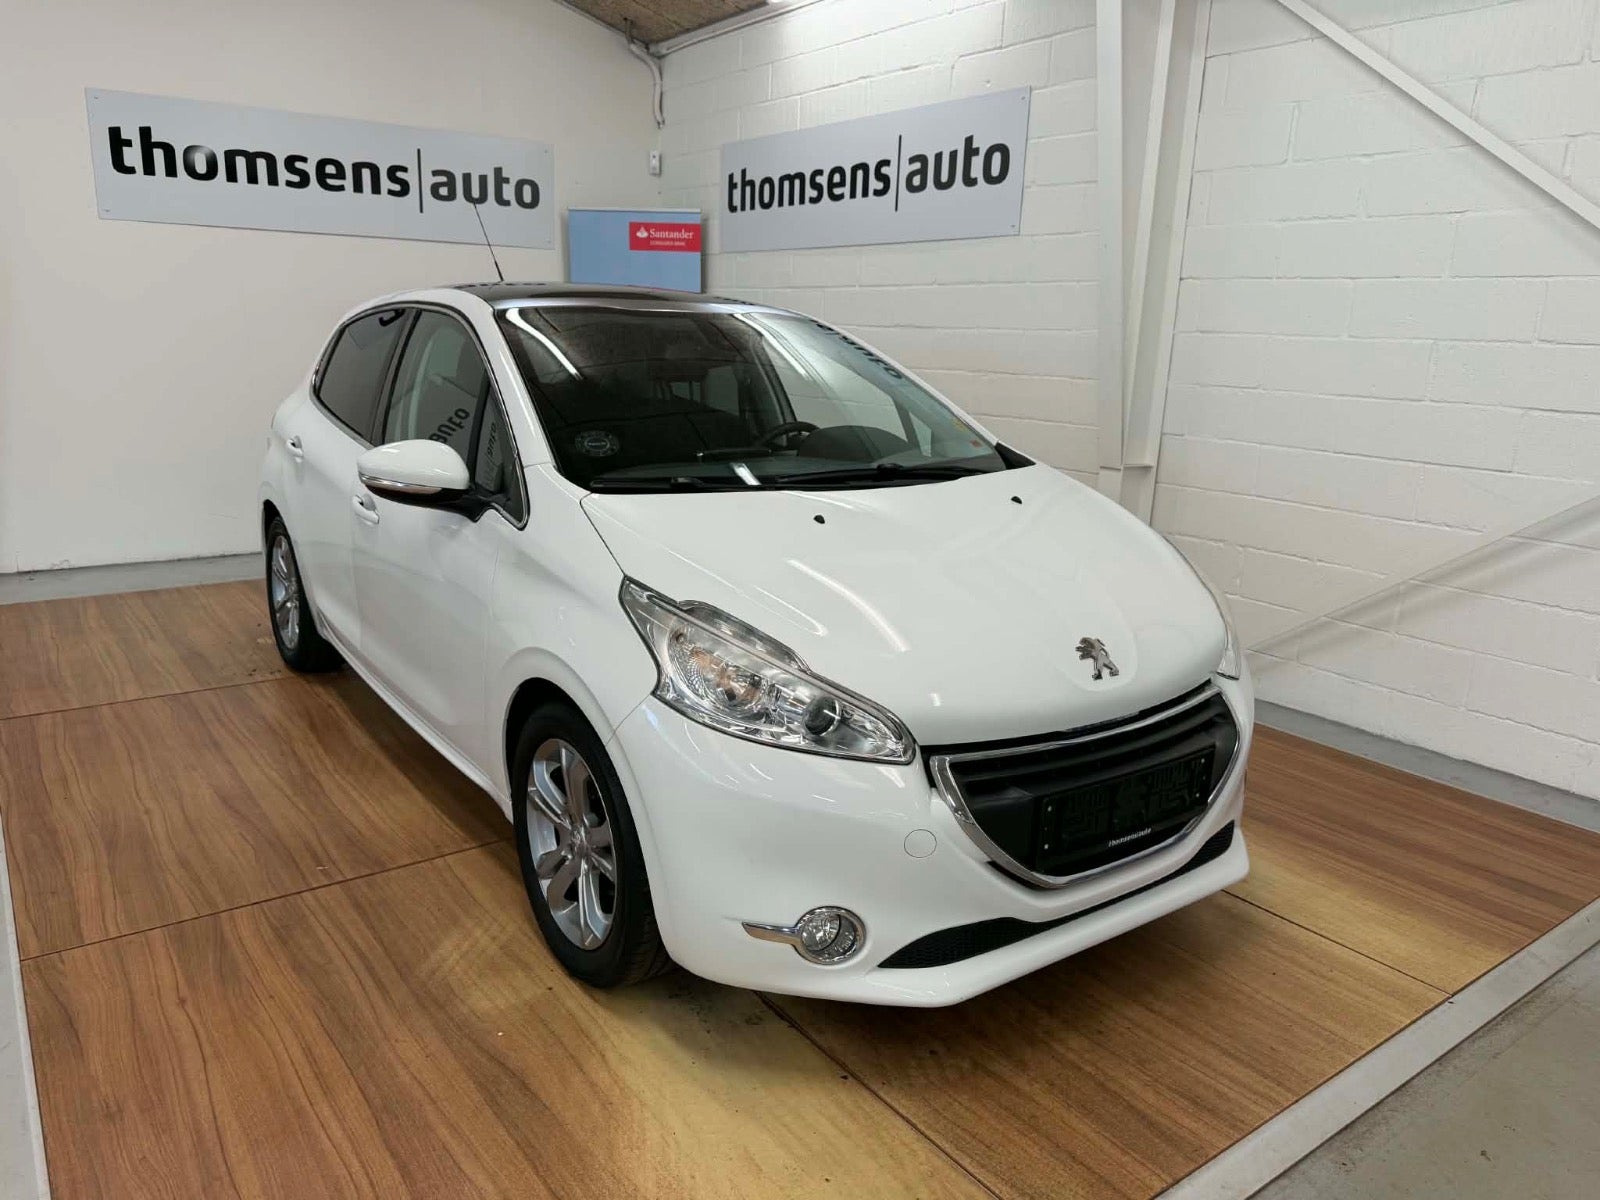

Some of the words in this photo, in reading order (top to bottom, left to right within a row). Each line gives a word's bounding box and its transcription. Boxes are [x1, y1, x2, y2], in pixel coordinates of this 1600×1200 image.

[108, 126, 410, 197] thomsens
[430, 167, 540, 209] auto
[728, 159, 891, 213] thomsens
[906, 135, 1010, 194] auto
[650, 228, 694, 239] Santander
